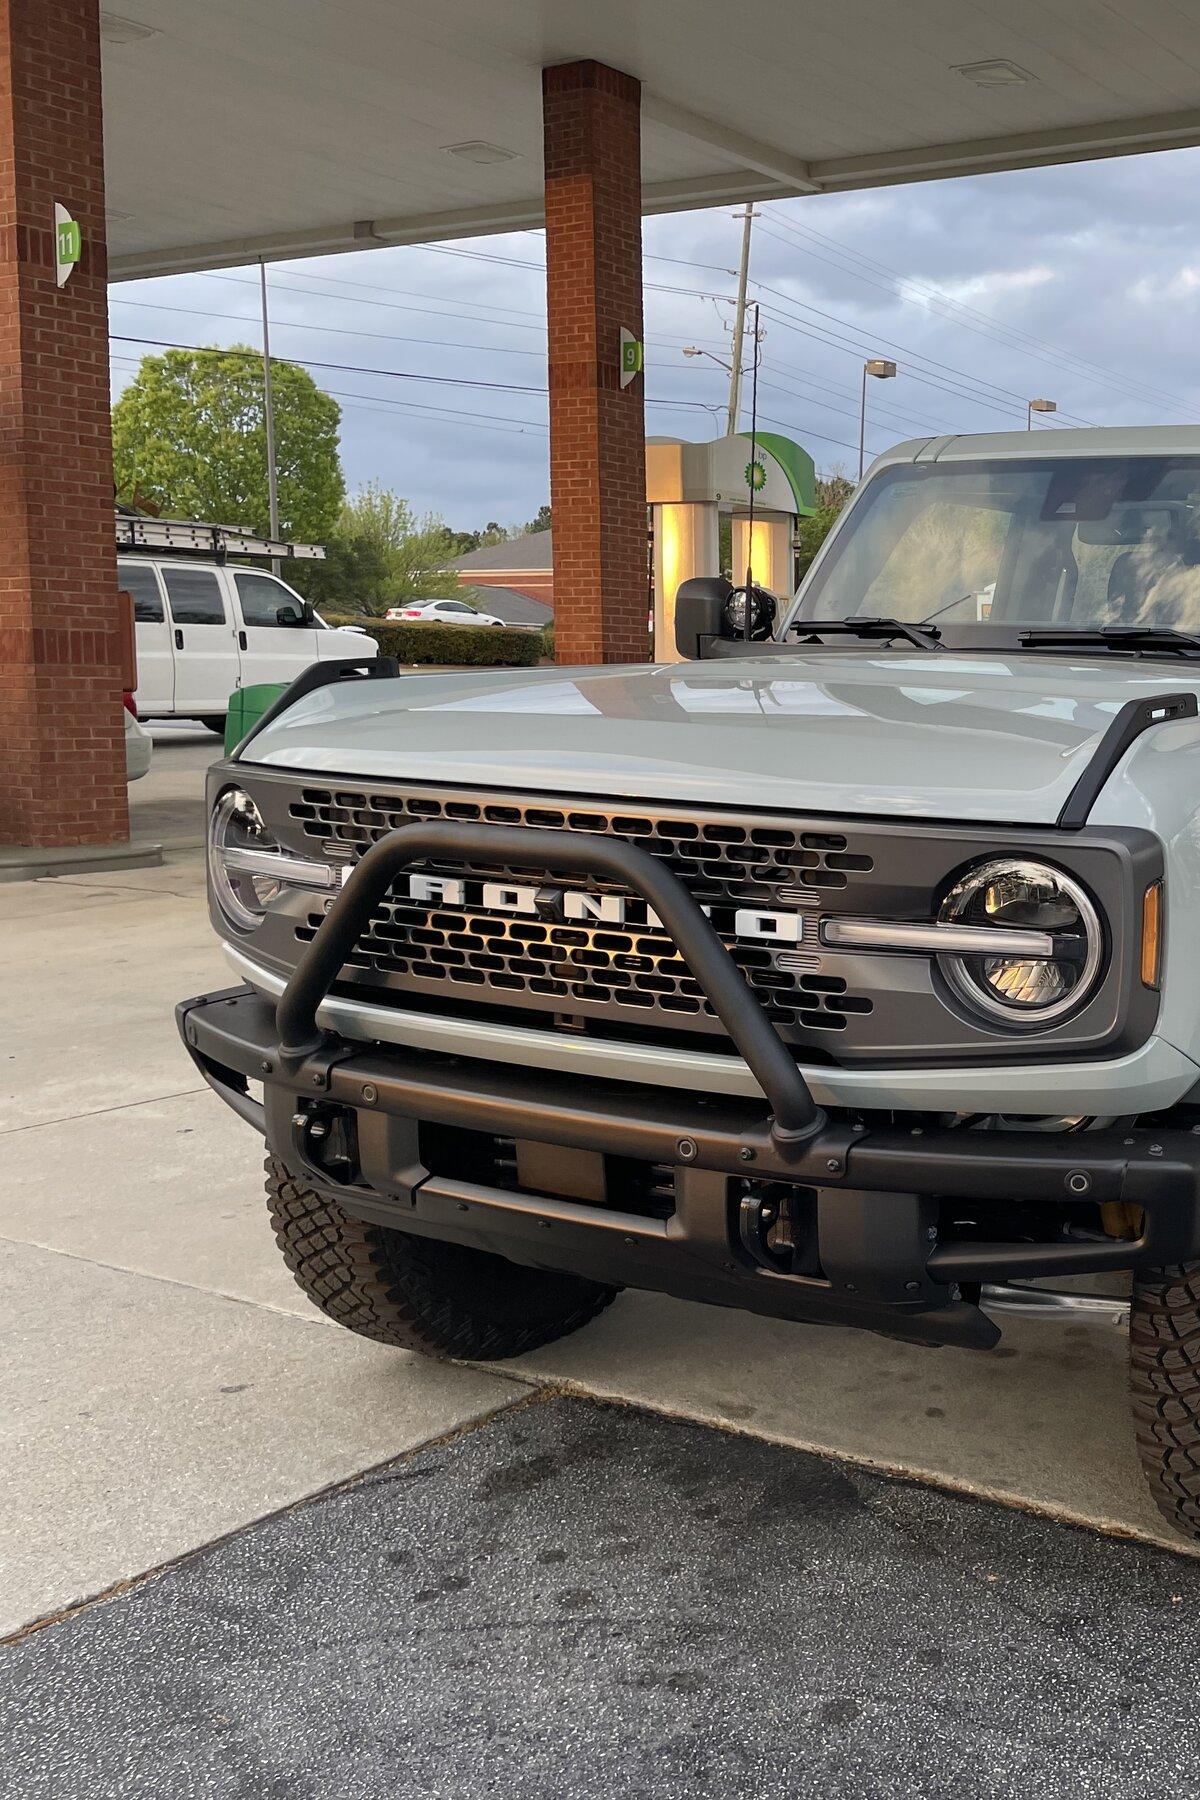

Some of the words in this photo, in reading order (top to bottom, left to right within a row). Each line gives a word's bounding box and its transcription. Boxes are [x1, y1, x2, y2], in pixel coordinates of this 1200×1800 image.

[60, 231, 73, 256] 11
[626, 348, 635, 366] 9
[342, 864, 802, 942] RONO
